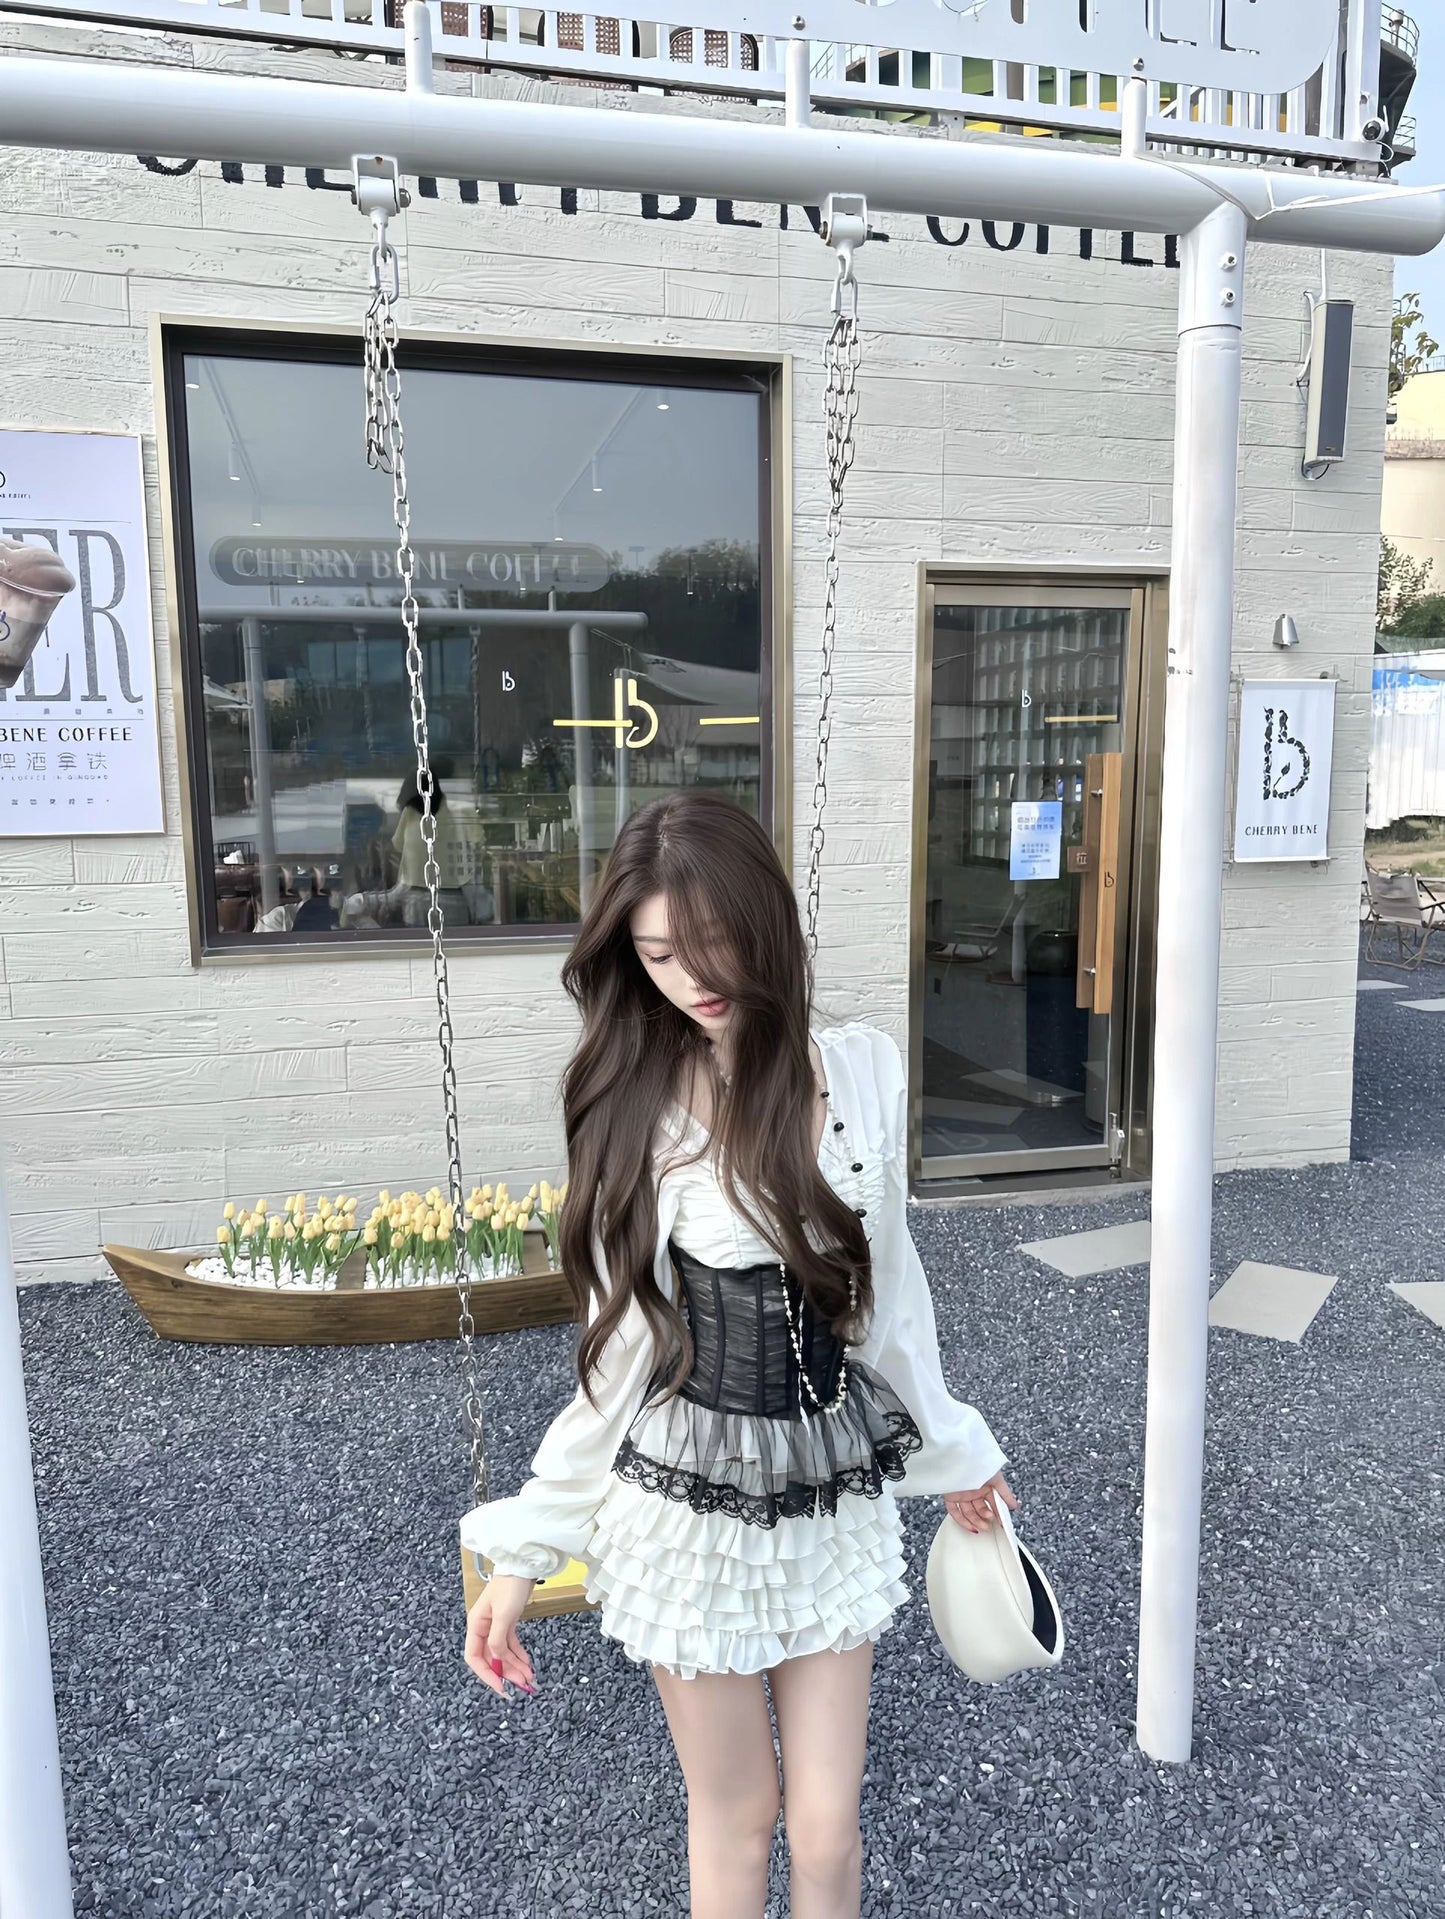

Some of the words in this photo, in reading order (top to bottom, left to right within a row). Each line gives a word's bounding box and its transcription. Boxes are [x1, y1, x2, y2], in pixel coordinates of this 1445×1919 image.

[232, 548, 361, 579] CHERRY
[371, 550, 456, 582] BNE
[58, 727, 133, 742] COFFEE
[1245, 825, 1288, 836] CHERRY
[1292, 824, 1318, 835] BENE
